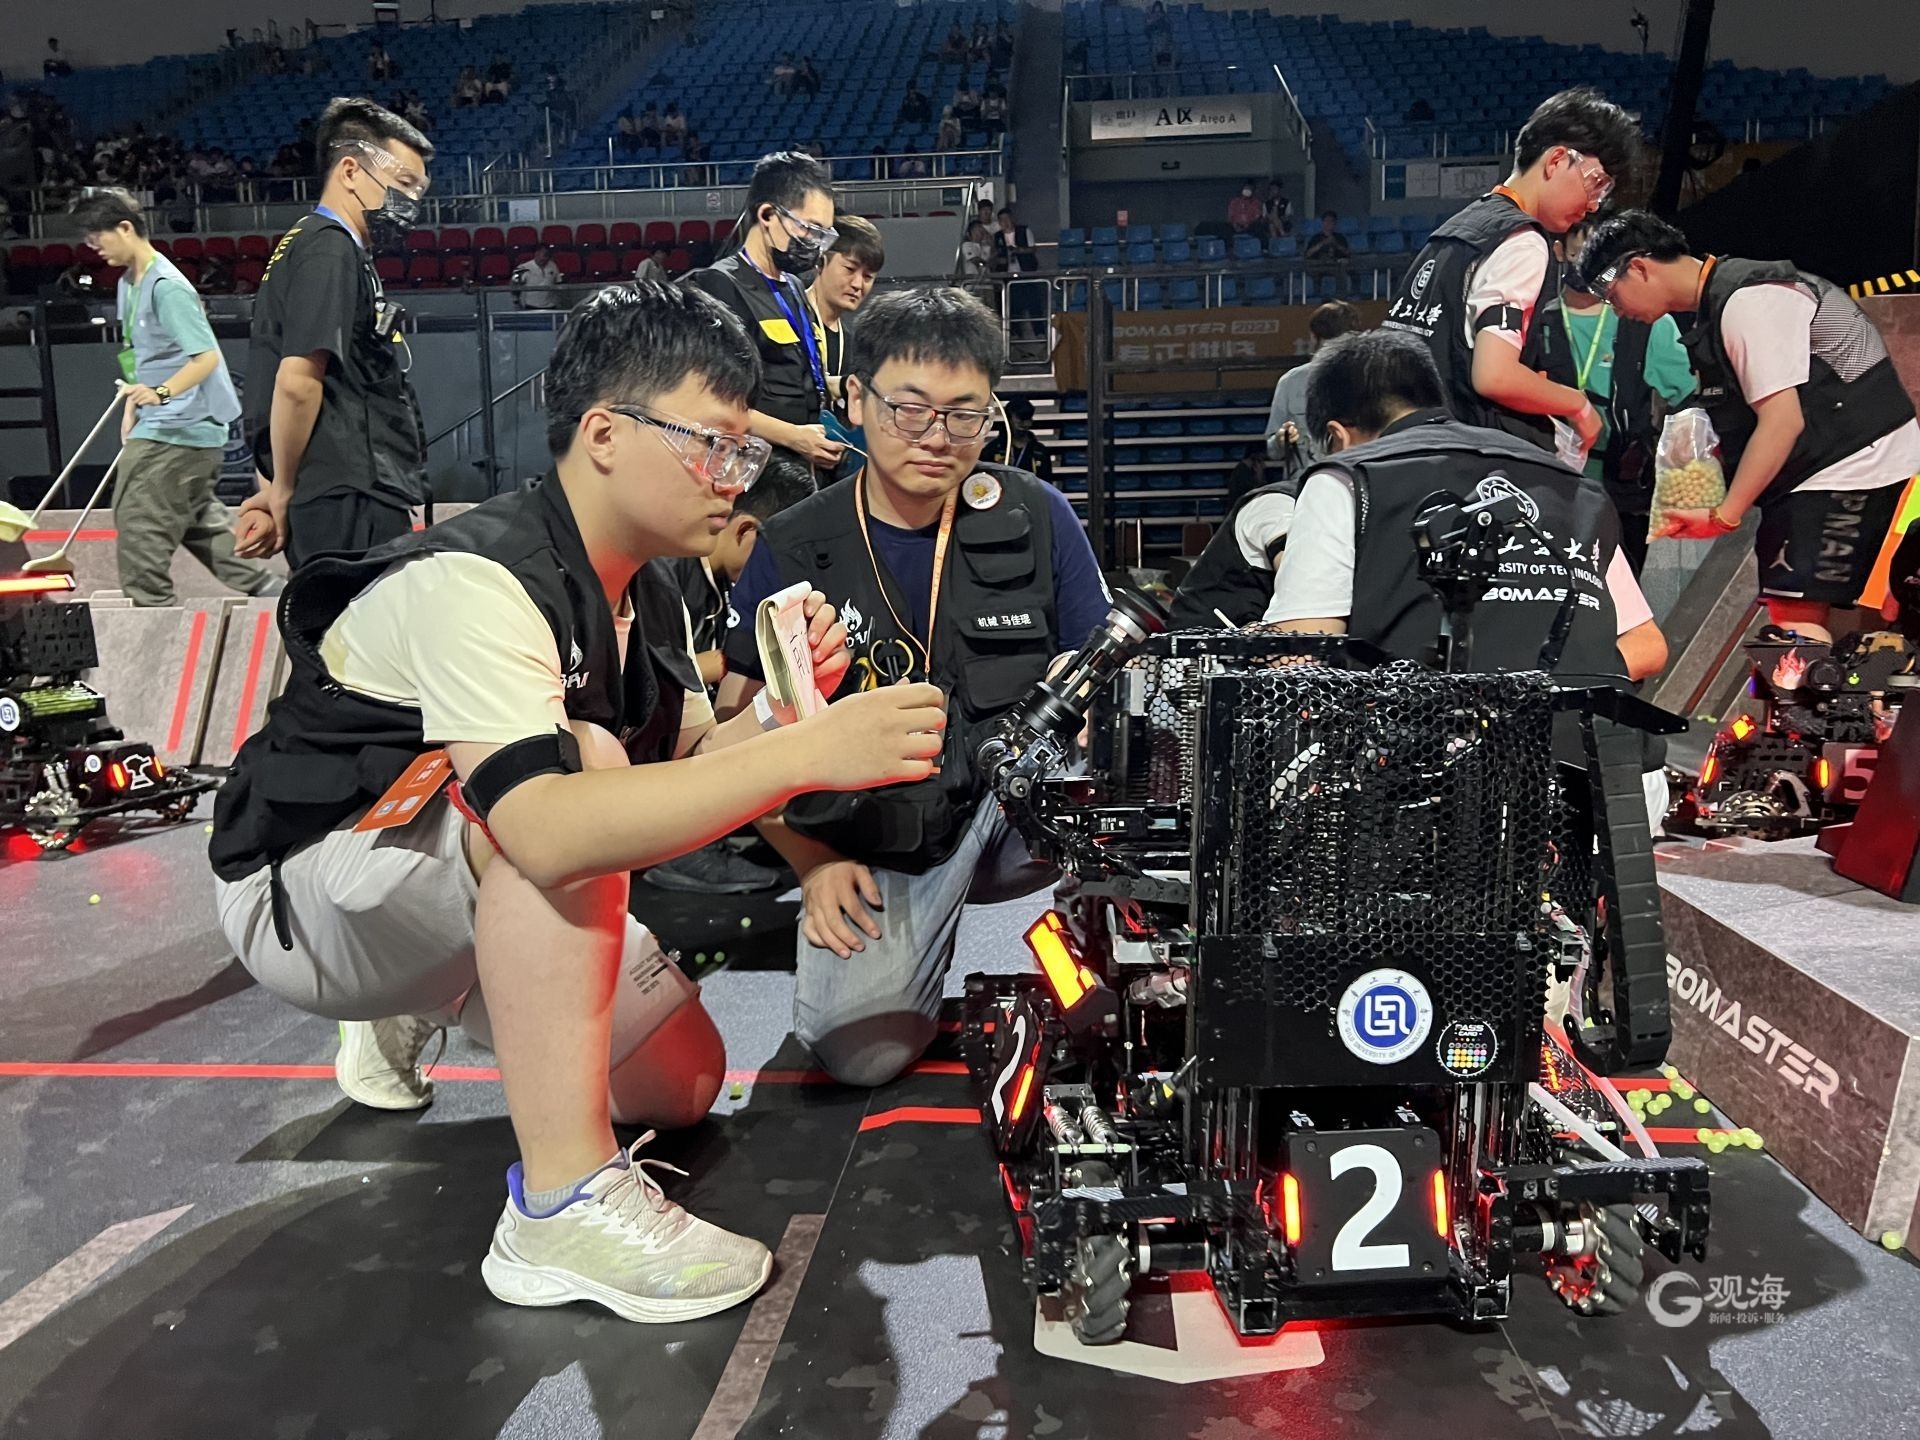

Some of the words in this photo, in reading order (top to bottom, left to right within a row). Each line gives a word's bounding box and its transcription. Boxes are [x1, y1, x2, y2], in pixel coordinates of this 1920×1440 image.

[1530, 564, 1547, 575] OF
[1482, 587, 1600, 611] BOMASER
[978, 616, 999, 627] 机械
[1844, 749, 1878, 800] 5
[1454, 1024, 1485, 1032] PASS
[1330, 1144, 1410, 1271] 2
